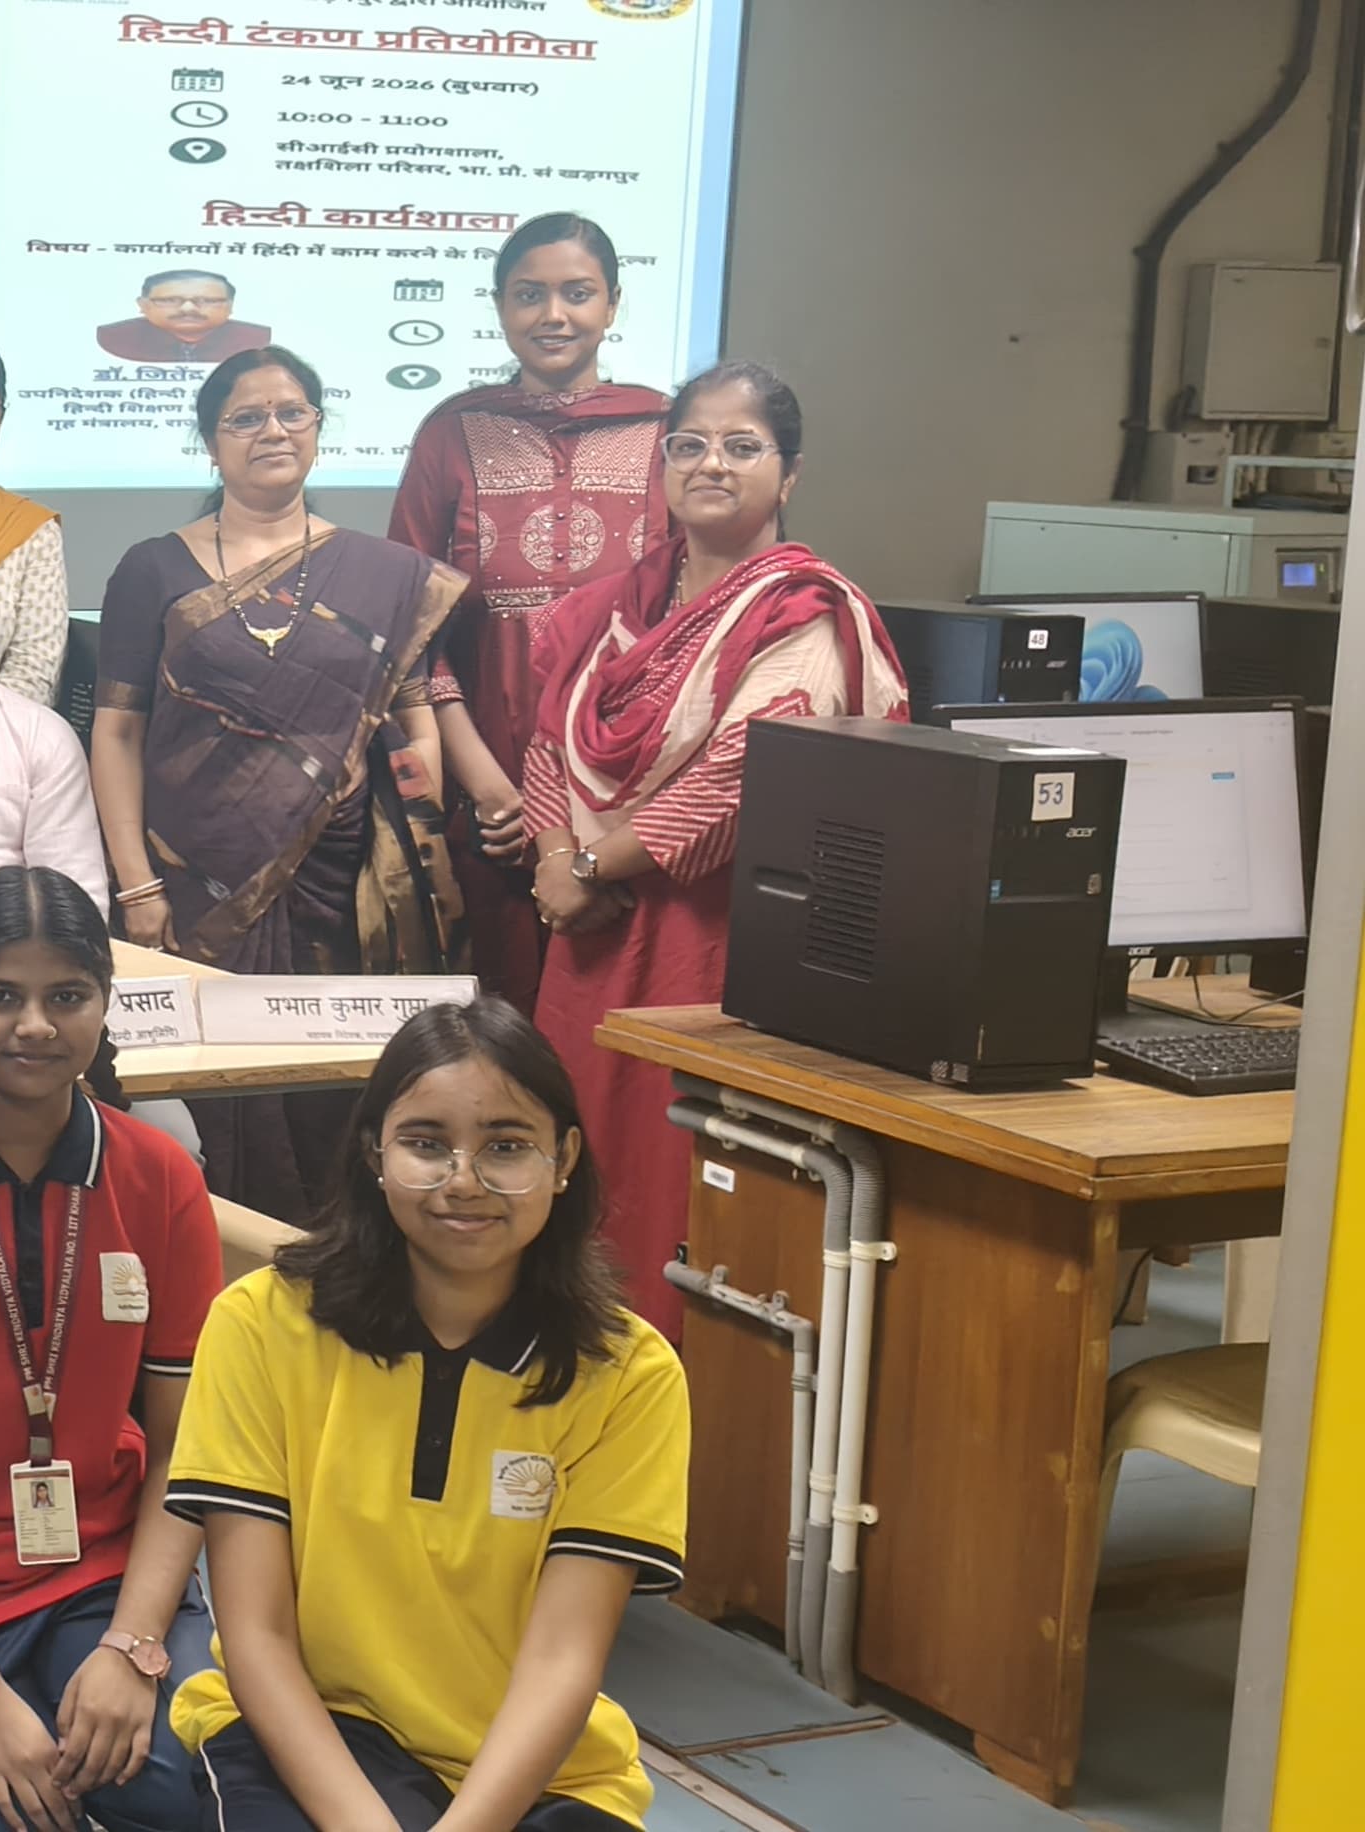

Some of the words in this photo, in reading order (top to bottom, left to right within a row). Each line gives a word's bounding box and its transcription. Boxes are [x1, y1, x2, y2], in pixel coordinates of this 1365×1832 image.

[118, 14, 234, 42] हिन्दी
[245, 20, 364, 47] टंकण
[374, 26, 599, 58] प्रतियोगिता
[281, 75, 312, 87] 24
[319, 74, 365, 91] जून
[371, 77, 435, 91] 2026
[441, 78, 540, 96] (बुधवार)
[276, 111, 353, 124] 10:00
[378, 114, 449, 127] 11:00
[274, 139, 380, 156] सीआईसी
[384, 143, 505, 162] प्रयोगशाला,
[274, 157, 371, 174] तक्षशिला
[378, 160, 452, 177] परिसर,
[557, 168, 641, 184] खड़गपुर
[201, 200, 312, 226] हिन्दी
[321, 204, 520, 231] कार्यशाला
[26, 239, 91, 254] विषय
[114, 241, 222, 256] कार्यालयों
[227, 242, 246, 256] में
[252, 242, 300, 257] हिंदी
[306, 243, 327, 258] में
[330, 246, 380, 259] काम
[385, 246, 438, 260] करने
[443, 246, 468, 261] के
[1030, 632, 1047, 647] 48
[1037, 781, 1065, 806] 53
[1065, 826, 1098, 839] acer
[117, 989, 177, 1013] प्रसाद
[264, 996, 322, 1017] प्रभात
[328, 996, 386, 1023] कुमार
